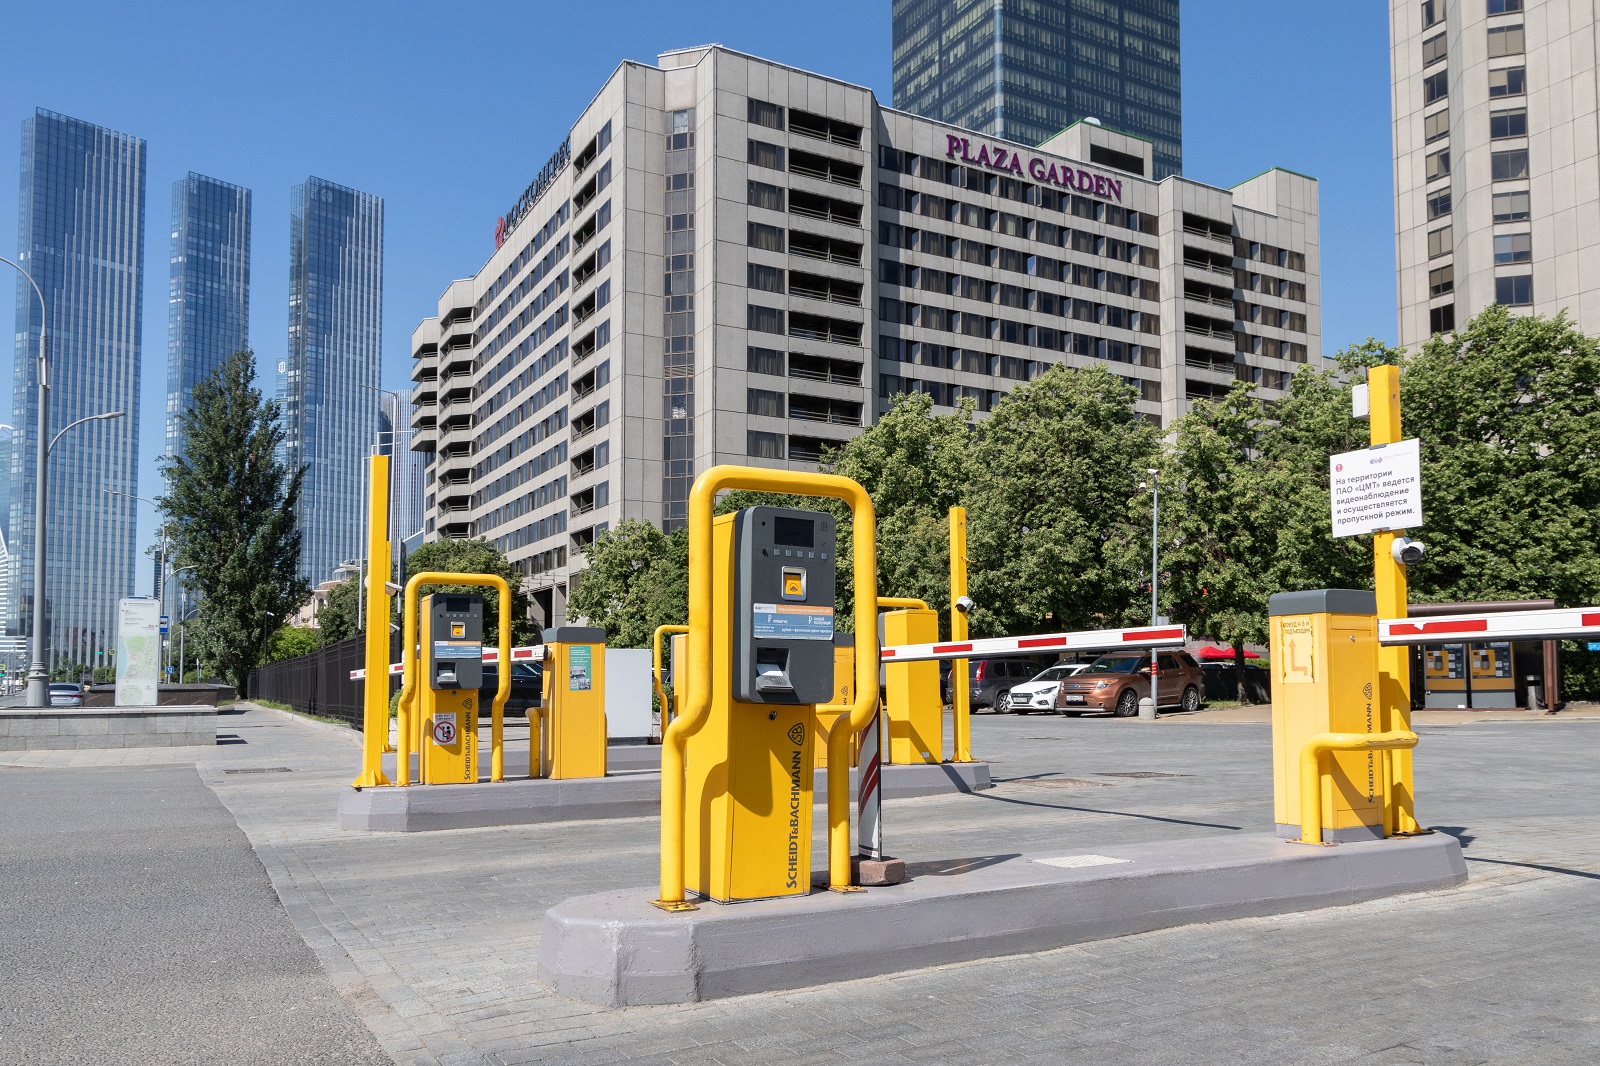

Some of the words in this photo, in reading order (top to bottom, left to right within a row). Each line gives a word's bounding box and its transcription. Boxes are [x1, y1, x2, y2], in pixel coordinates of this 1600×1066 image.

[946, 133, 1024, 176] PLAZA
[1028, 157, 1123, 204] GARDEN
[1336, 478, 1345, 486] На
[1347, 470, 1393, 484] территории
[1336, 486, 1353, 495] ПАО
[1355, 481, 1380, 493] «ЦМТ»
[1336, 487, 1410, 505] видеонаблюдение
[1343, 498, 1408, 514] осуществляется
[1337, 511, 1384, 525] пропускной
[1385, 507, 1415, 519] режим.
[786, 750, 802, 889] SCHEIDT&BACHMANN
